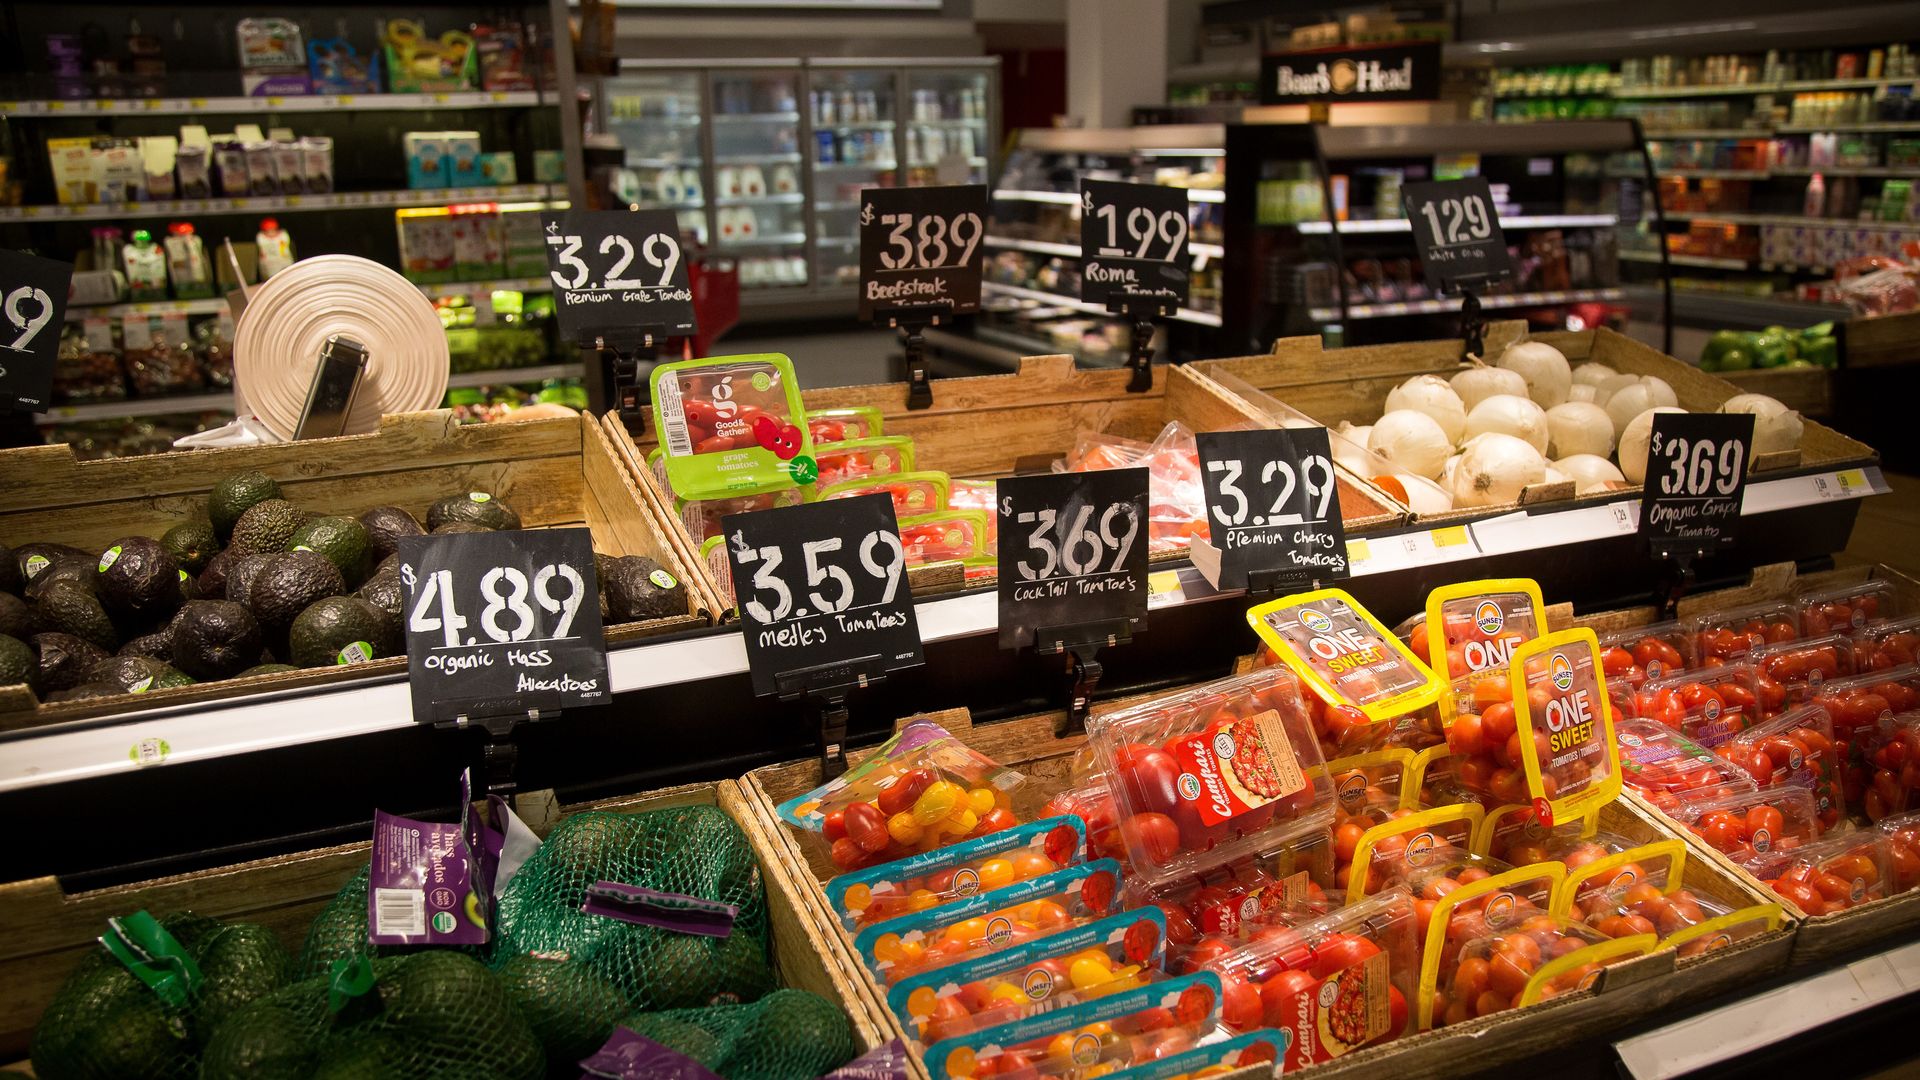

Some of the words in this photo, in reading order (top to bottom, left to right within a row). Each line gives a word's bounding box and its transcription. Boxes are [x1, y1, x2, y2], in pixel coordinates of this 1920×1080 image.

[1357, 57, 1412, 92] Head
[1086, 262, 1140, 283] Roma
[565, 291, 613, 305] Premium
[867, 277, 948, 300] Beefsteak
[717, 461, 760, 472] tomatoes
[723, 452, 749, 463] grape
[1207, 455, 1335, 527] 3.29
[1650, 503, 1699, 533] Organic
[1701, 499, 1738, 519] Grape
[1226, 530, 1283, 549] Premium
[1477, 617, 1503, 628] SUNSET
[1309, 627, 1372, 660] ONE
[424, 649, 495, 675] Organic
[1327, 646, 1384, 673] SWEET
[1553, 671, 1573, 683] SUNSET
[1545, 689, 1592, 732] ONE
[1550, 721, 1594, 753] SWEET
[1552, 750, 1578, 768] TOMATOES
[1580, 742, 1600, 758] TOMATES
[1185, 774, 1198, 799] SUNSET
[1193, 740, 1232, 817] Campari
[444, 832, 455, 858] hass
[435, 890, 444, 908] GMO
[443, 890, 451, 907] NON
[954, 881, 980, 893] SUNSET
[987, 930, 1013, 942] SUNSET
[1025, 982, 1052, 996] SUNSET
[1297, 991, 1314, 1069] Campari
